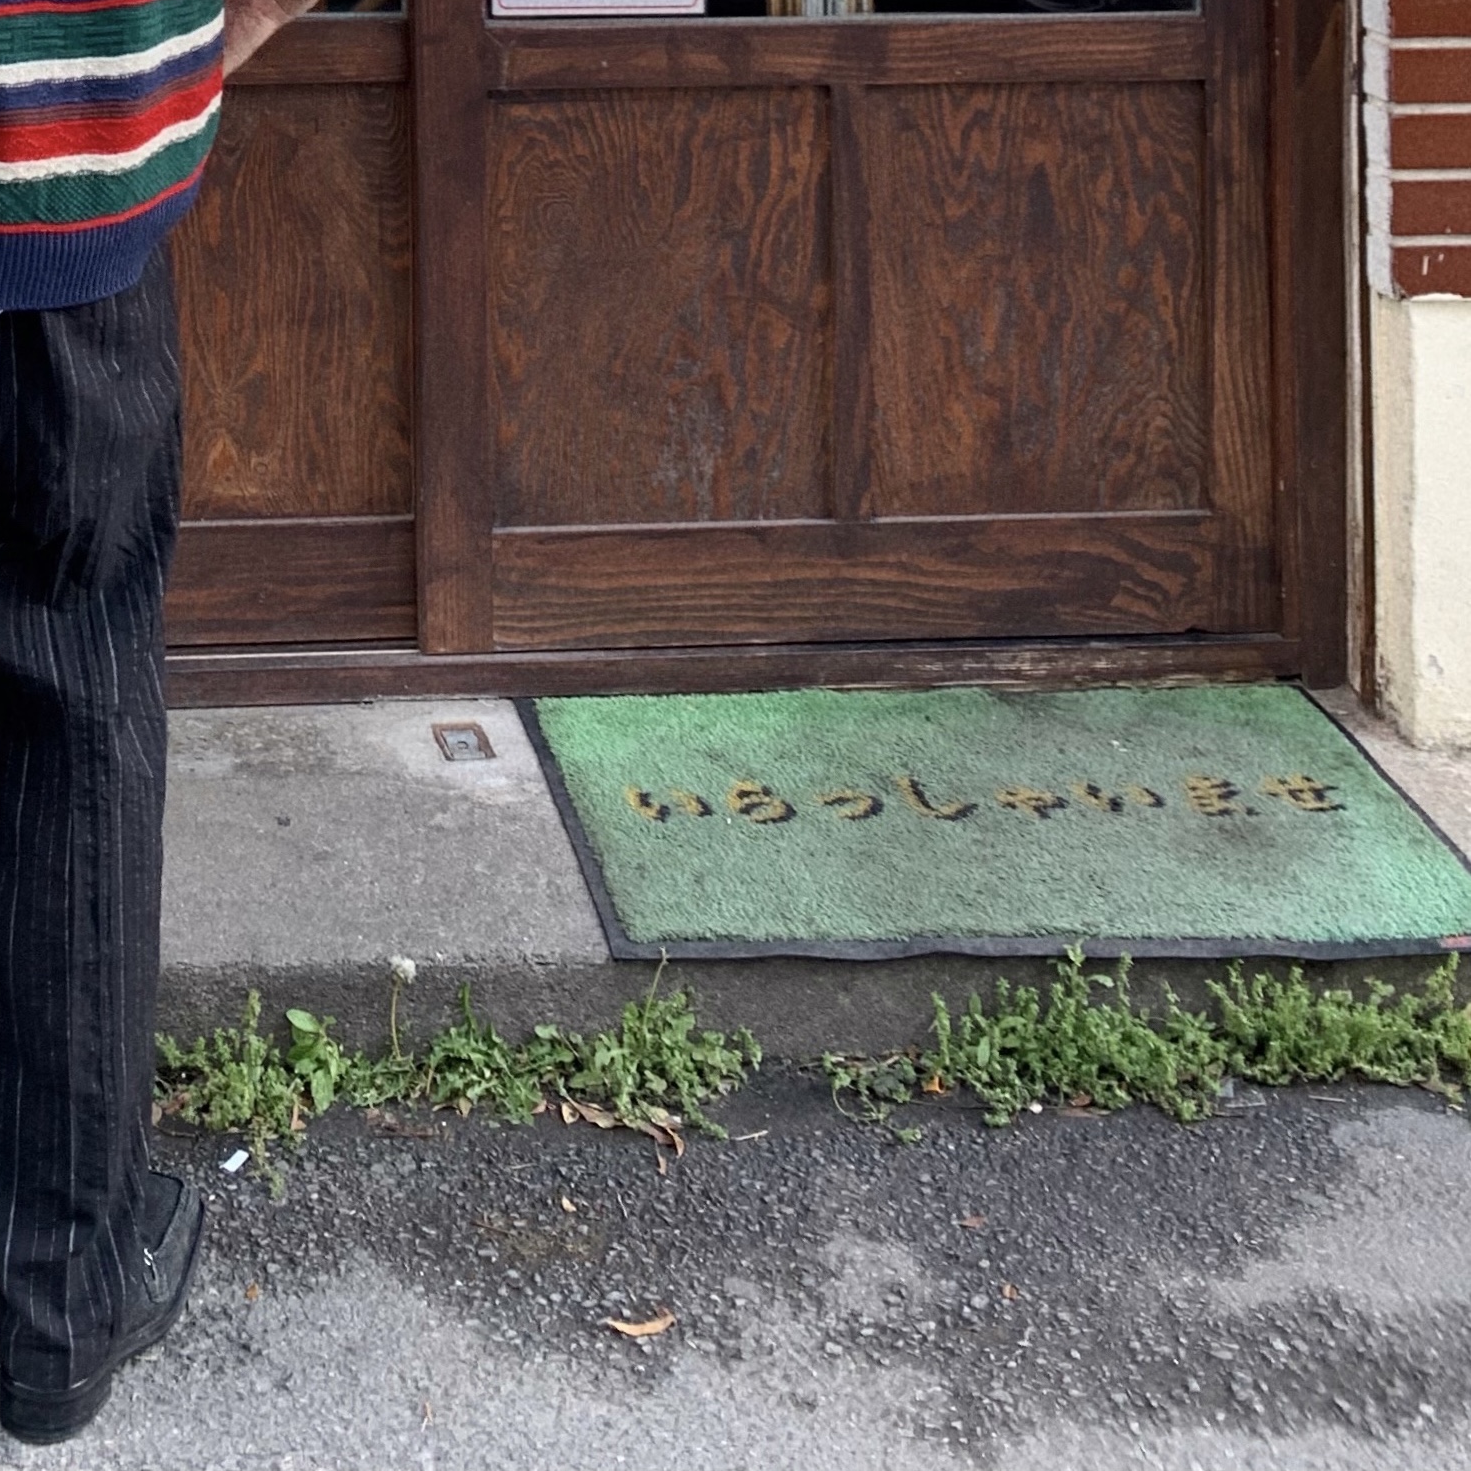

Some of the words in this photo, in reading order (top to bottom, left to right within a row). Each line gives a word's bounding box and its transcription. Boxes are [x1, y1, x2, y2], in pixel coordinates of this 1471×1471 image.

[625, 773, 1347, 825] いらっしゃいませ
